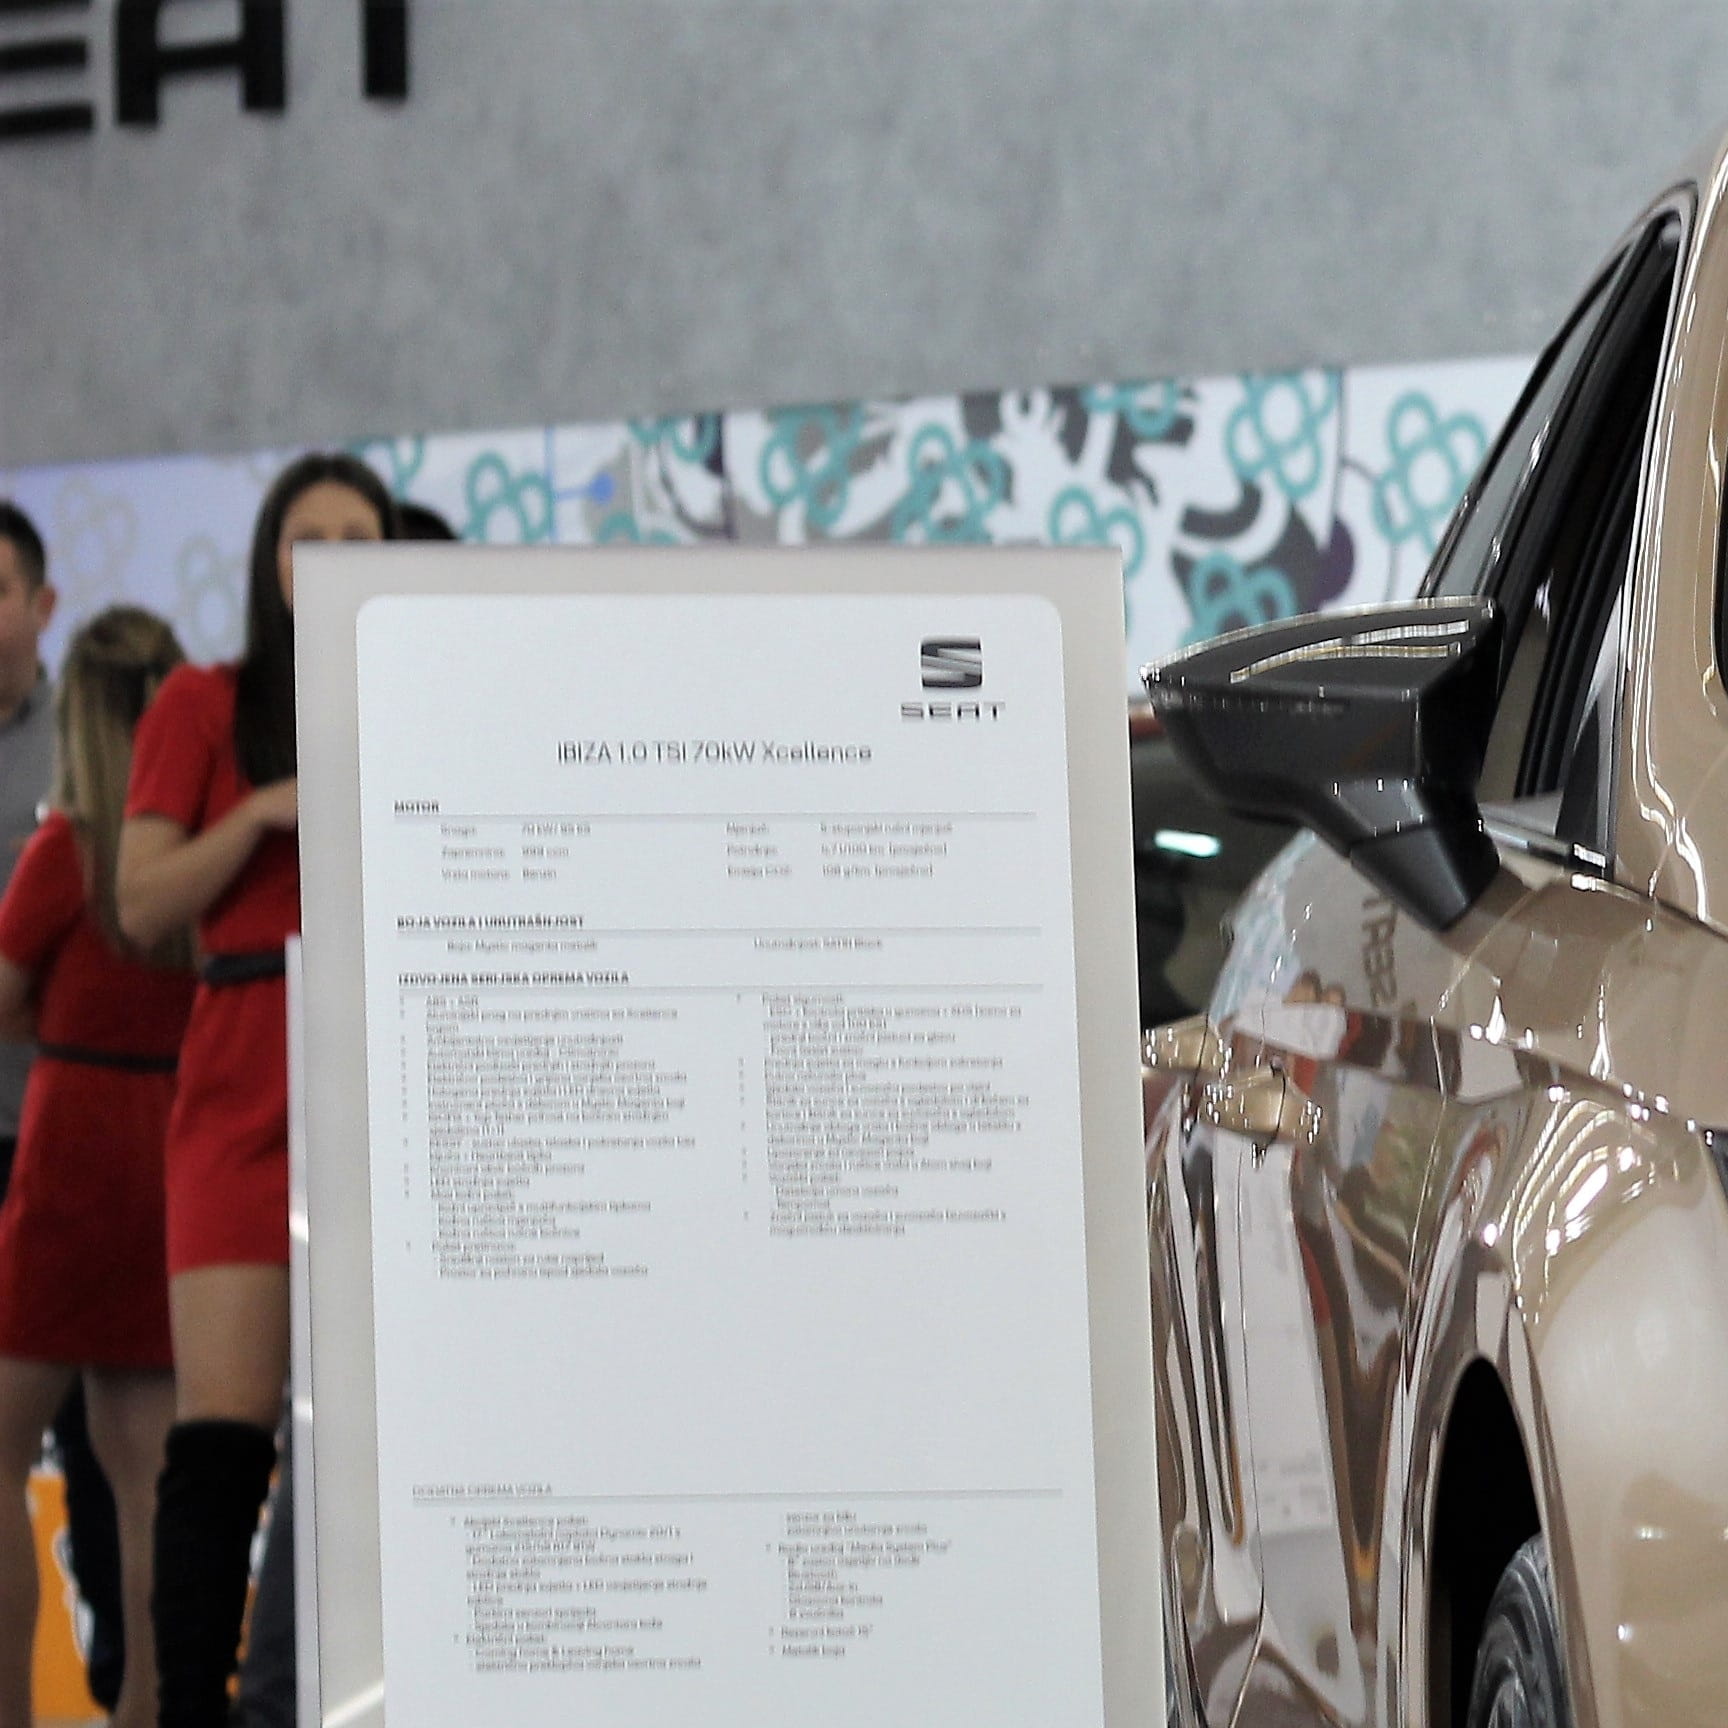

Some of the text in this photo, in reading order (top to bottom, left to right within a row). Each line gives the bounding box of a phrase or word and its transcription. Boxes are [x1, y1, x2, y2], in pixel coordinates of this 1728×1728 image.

[899, 701, 1006, 721] SEAT
[556, 740, 872, 764] IBIZA 1.0 TSI 70kW Xcellence
